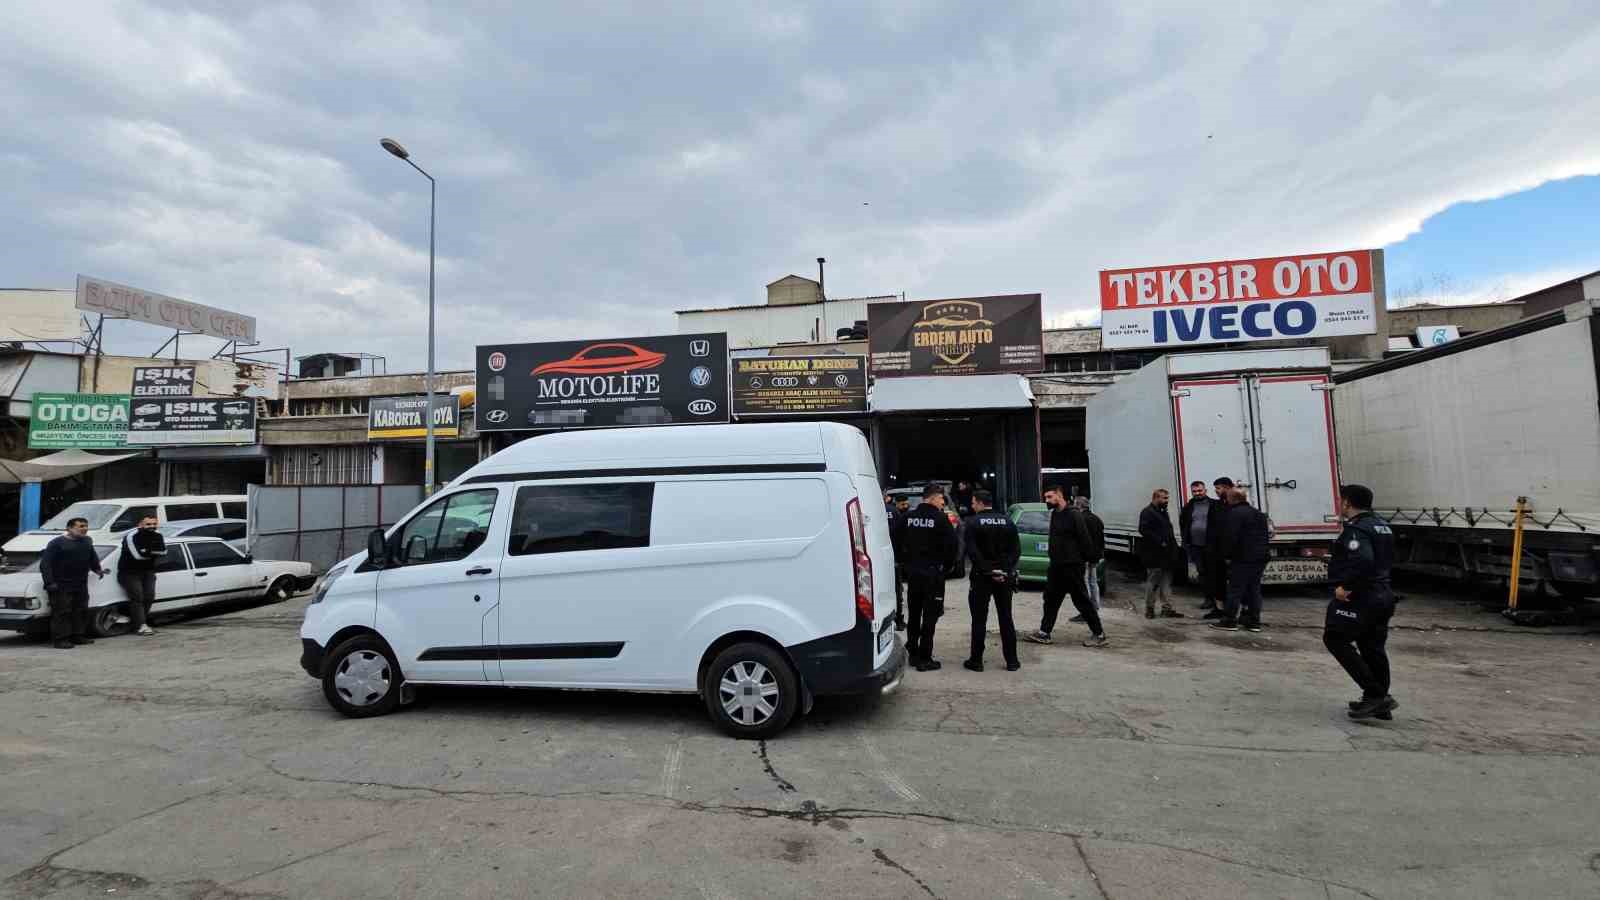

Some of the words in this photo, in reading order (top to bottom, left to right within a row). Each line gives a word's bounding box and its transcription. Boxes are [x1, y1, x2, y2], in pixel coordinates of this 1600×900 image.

[1272, 256, 1359, 297] OTO
[1152, 300, 1318, 344] IVECO
[913, 331, 957, 347] ERDEM
[959, 329, 993, 345] AUTO
[135, 368, 193, 381] IŞIK
[133, 383, 191, 396] ELEKTRİK
[536, 370, 661, 398] MOTOLİFE
[37, 403, 128, 422] OTOGA
[164, 402, 217, 415] IŞIK
[692, 403, 712, 411] KIA
[373, 409, 422, 427] KABORTA
[433, 406, 454, 424] OYA
